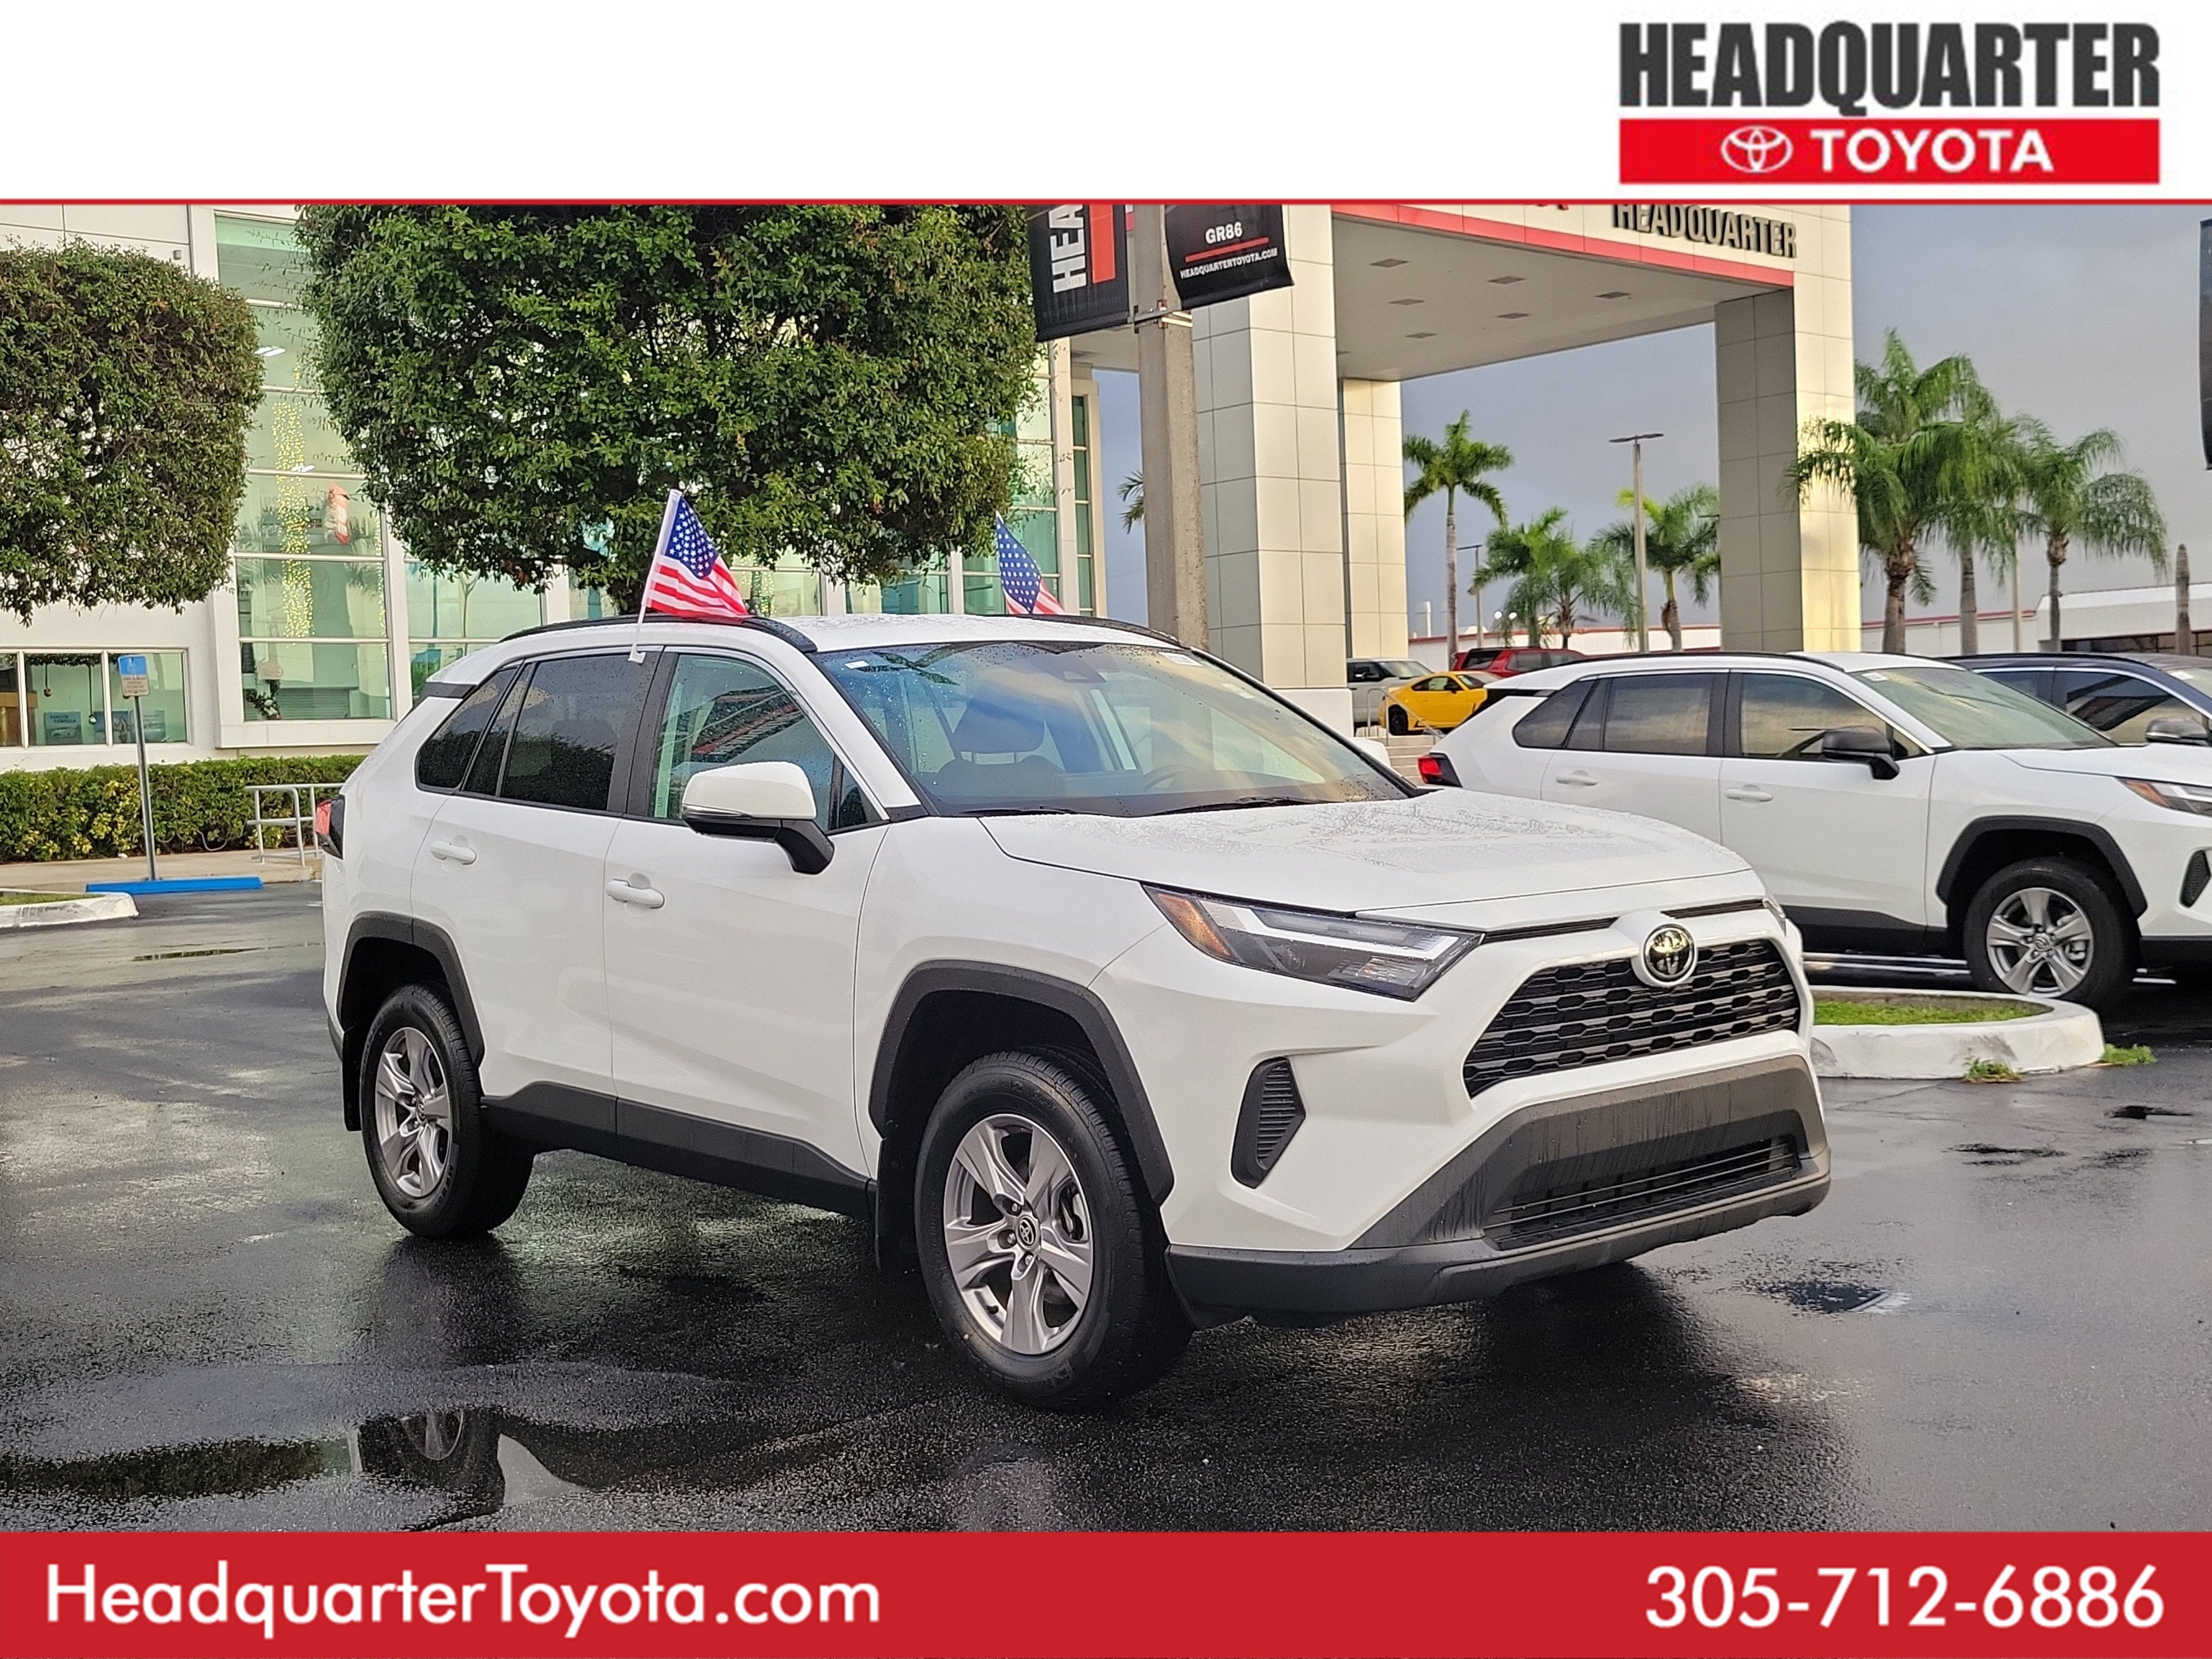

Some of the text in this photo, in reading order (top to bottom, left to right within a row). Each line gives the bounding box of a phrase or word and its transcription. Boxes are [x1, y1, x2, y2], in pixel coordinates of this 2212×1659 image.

[1205, 222, 1243, 244] GR86
[1611, 204, 1797, 258] HEADQUARTER
[1180, 247, 1278, 279] HEADQUARTERTOYOTA.COM
